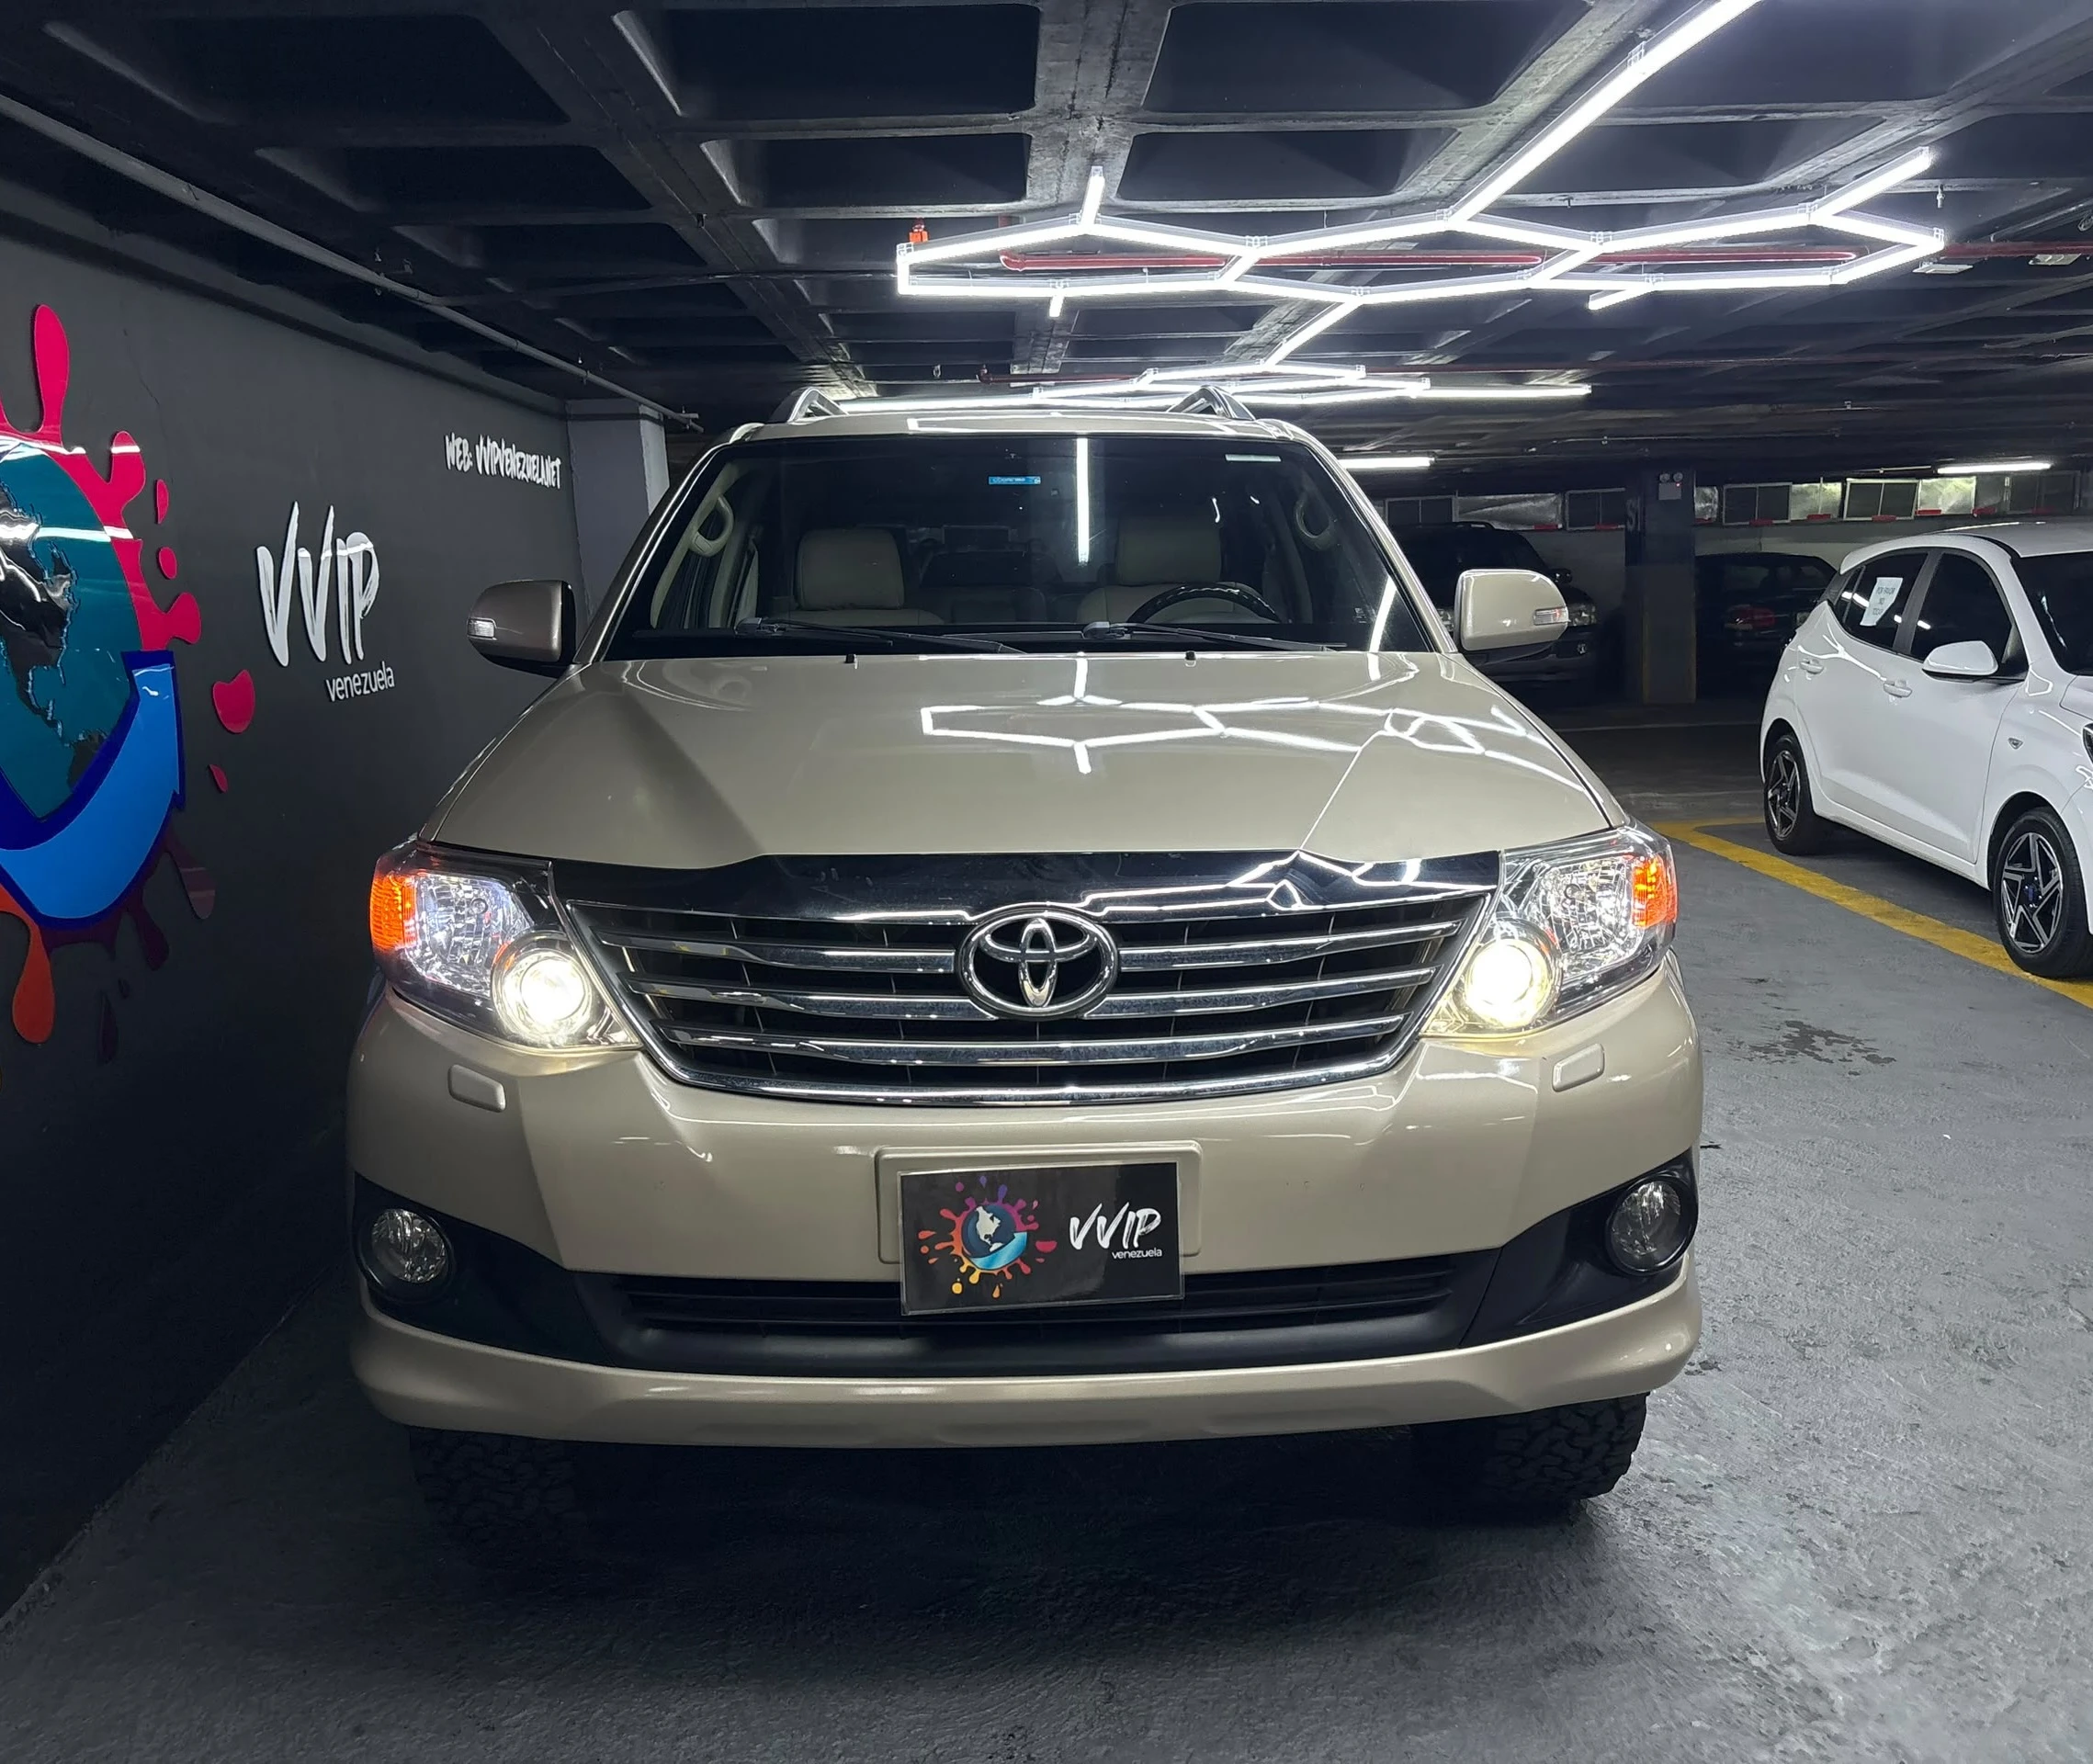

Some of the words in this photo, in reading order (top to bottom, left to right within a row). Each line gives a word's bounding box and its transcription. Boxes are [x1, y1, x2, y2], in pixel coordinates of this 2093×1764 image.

[445, 432, 473, 472] WEB:
[256, 501, 379, 667] VVIP
[324, 661, 395, 702] venezuela
[1069, 1202, 1161, 1250] VVIP
[1111, 1246, 1162, 1260] venezuela
